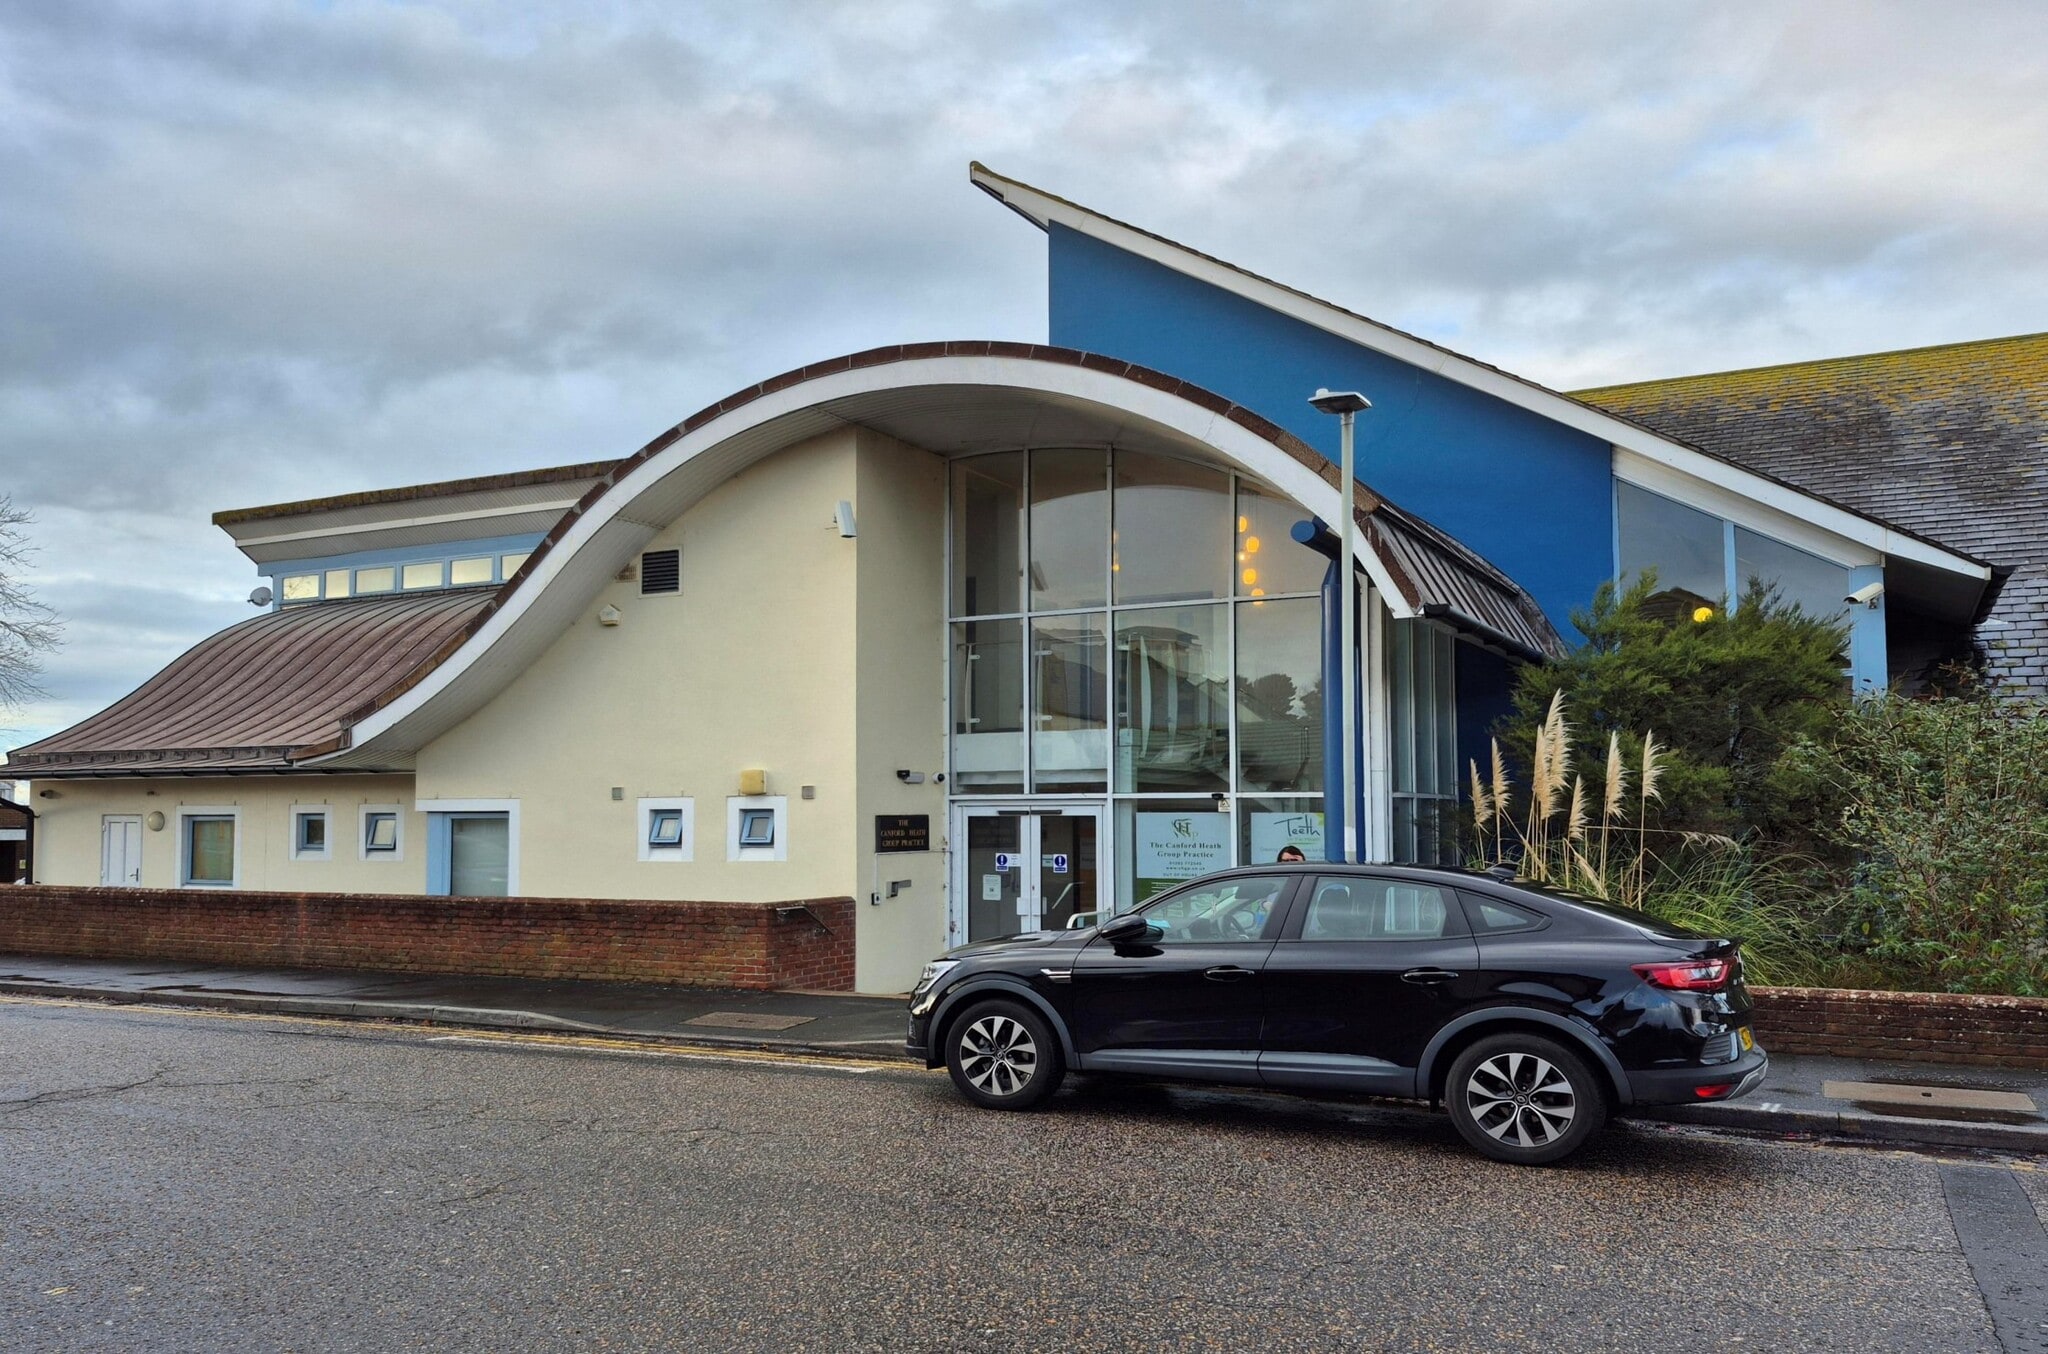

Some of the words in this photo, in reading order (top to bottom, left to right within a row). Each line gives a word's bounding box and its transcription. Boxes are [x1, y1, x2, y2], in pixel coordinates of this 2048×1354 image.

[898, 819, 909, 827] THE
[1273, 814, 1321, 837] Teeth
[880, 829, 905, 837] CANFORD
[1157, 850, 1181, 858] Group
[1183, 850, 1214, 858] Practice
